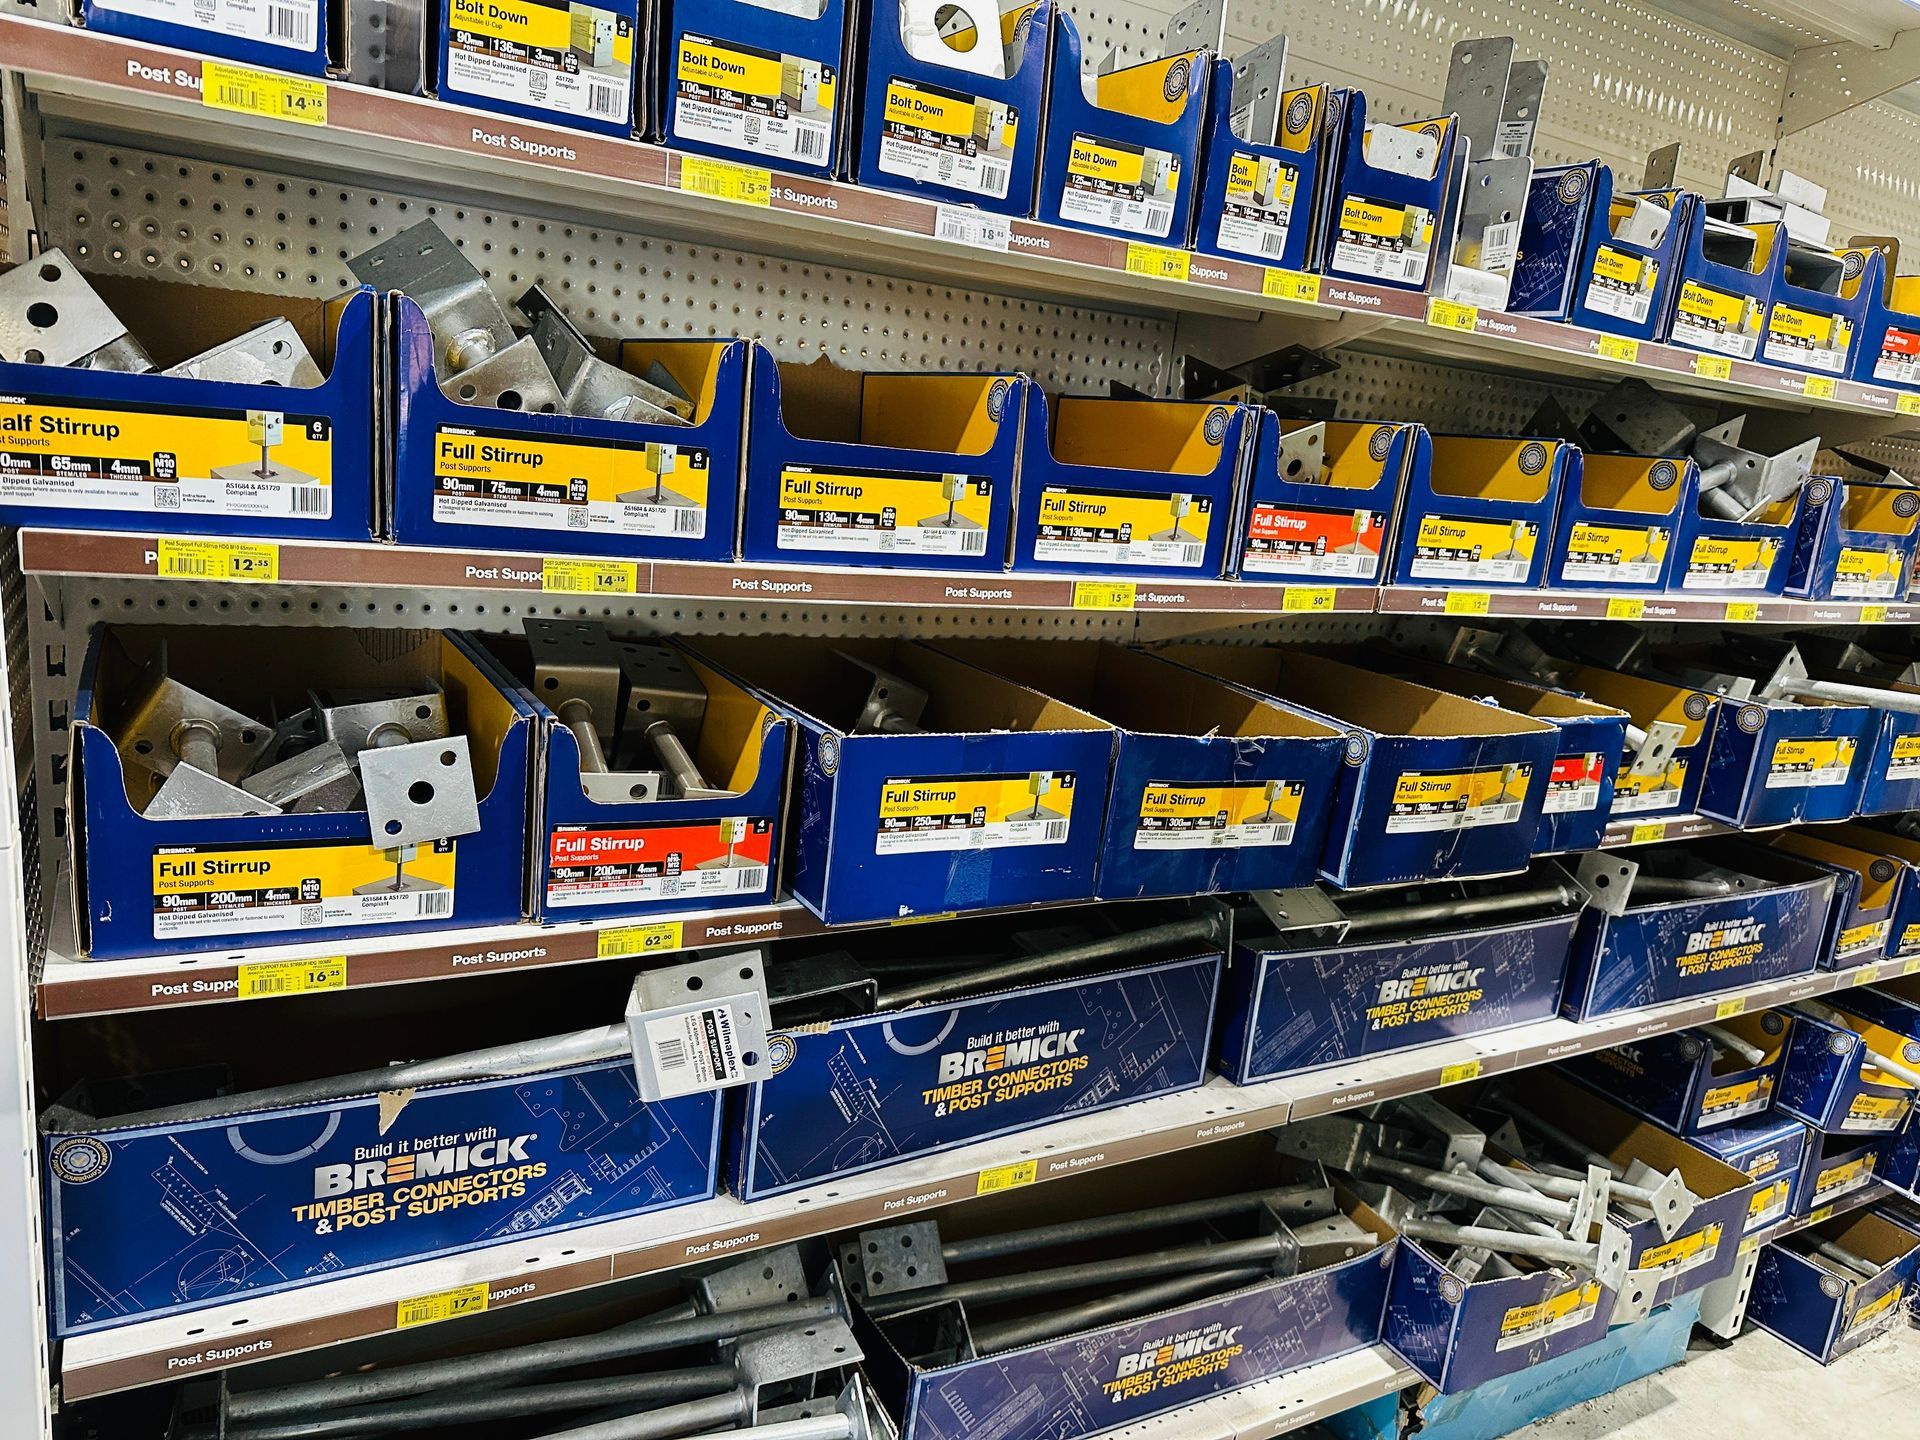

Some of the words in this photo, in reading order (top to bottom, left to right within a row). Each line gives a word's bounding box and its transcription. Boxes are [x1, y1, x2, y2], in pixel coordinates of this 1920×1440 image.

[456, 0, 484, 15] Bolt
[489, 5, 528, 25] Down
[457, 31, 484, 47] 90mm
[494, 39, 525, 56] 136mm
[683, 50, 707, 67] Bolt
[712, 58, 745, 75] Down
[127, 60, 171, 84] Post
[681, 81, 709, 97] 100mm
[890, 94, 911, 109] Bolt
[915, 100, 943, 117] Down
[890, 122, 914, 137] 115mm
[472, 129, 506, 148] Post
[510, 135, 576, 160] Supports
[1073, 149, 1091, 162] Bolt
[1093, 154, 1117, 168] Down
[1232, 164, 1248, 176] Bolt
[1230, 174, 1252, 188] Down
[784, 189, 838, 209] Supports
[1345, 207, 1360, 218] Bolt
[1363, 211, 1382, 223] Down
[1598, 255, 1608, 264] Bolt
[1609, 258, 1623, 269] Down
[1190, 264, 1228, 280] Supports
[1329, 289, 1346, 300] Post
[1348, 291, 1381, 306] Supports
[1683, 290, 1695, 300] Bolt
[1697, 293, 1713, 306] Down
[1773, 311, 1785, 321] Bolt
[1786, 315, 1802, 326] Down
[0, 414, 31, 433] alf
[40, 416, 120, 440] Stirrup
[313, 421, 322, 432] 6
[8, 435, 50, 447] Supports
[155, 458, 175, 468] M10
[441, 442, 475, 460] Full
[481, 446, 543, 468] Stirrup
[695, 452, 702, 461] 6
[51, 456, 91, 473] 65mm
[111, 459, 141, 475] 4mm
[440, 462, 456, 470] Post
[458, 463, 491, 474] Supports
[3, 476, 31, 487] Dipped
[32, 478, 75, 487] Galvanised
[443, 478, 474, 492] 90mm
[490, 481, 521, 495] 75mm
[537, 484, 559, 498] 4mm
[785, 479, 812, 494] Full
[815, 482, 862, 498] Stirrup
[439, 498, 450, 506] Hot
[452, 499, 472, 508] Dipped
[474, 500, 507, 509] Galvanised
[1044, 498, 1065, 511] Full
[1069, 500, 1106, 516] Stirrup
[785, 510, 810, 521] 90mm
[819, 512, 848, 524] 130mm
[856, 514, 874, 525] 4mm
[1254, 514, 1272, 526] Full
[1275, 516, 1306, 530] Stirrup
[1423, 525, 1437, 535] Full
[1439, 526, 1466, 537] Stirrup
[1573, 531, 1584, 541] Full
[1586, 532, 1609, 543] Stirrup
[1695, 544, 1707, 553] Full
[1708, 545, 1728, 554] Stirrup
[466, 566, 499, 580] Post
[732, 579, 759, 590] Post
[762, 580, 812, 593] Supports
[945, 587, 967, 597] Post
[969, 588, 1012, 599] Supports
[1148, 593, 1185, 603] Supports
[1553, 603, 1577, 612] Supports
[1655, 608, 1676, 616] Supports
[1787, 747, 1805, 755] Stirrup
[1399, 781, 1418, 792] Full
[1420, 782, 1451, 792] Stirrup
[886, 791, 909, 803] Full
[913, 789, 956, 802] Stirrup
[1146, 794, 1166, 804] Full
[1170, 793, 1205, 806] Stirrup
[915, 816, 942, 826] 250mm
[1169, 818, 1192, 826] 300mm
[556, 839, 585, 853] Full
[589, 837, 645, 852] Stirrup
[159, 862, 196, 877] Full
[202, 860, 271, 875] Stirrup
[595, 865, 627, 876] 200mm
[159, 880, 176, 888] Post
[178, 878, 214, 888] Supports
[211, 892, 252, 903] 200mm
[706, 927, 731, 937] Post
[734, 921, 782, 935] Supports
[452, 955, 485, 966] Post
[488, 947, 546, 963] Supports
[1676, 952, 1707, 968] TIMBER
[1709, 943, 1763, 963] CONNECTORS
[1686, 963, 1709, 975] POST
[1711, 955, 1753, 971] SUPPORTS
[152, 983, 190, 996] Post
[1366, 1003, 1407, 1020] TIMBER
[1410, 989, 1483, 1010] CONNECTORS
[1381, 1014, 1411, 1028] POST
[1413, 1002, 1470, 1022] SUPPORTS
[706, 1019, 715, 1037] POST
[967, 1036, 992, 1050] Build
[995, 1033, 1002, 1044] it
[1005, 1026, 1037, 1043] better
[1039, 1021, 1060, 1034] with
[721, 1018, 736, 1072] Wilmaplex
[710, 1037, 722, 1072] SUPPORT
[922, 1078, 982, 1105] TIMBER
[987, 1055, 1089, 1091] CONNECTORS
[934, 1103, 947, 1118] &
[948, 1093, 992, 1114] POST
[995, 1072, 1073, 1102] SUPPORTS
[1197, 1127, 1214, 1138] Post
[1214, 1120, 1245, 1134] Supports
[355, 1143, 394, 1161] Build
[398, 1140, 409, 1153] it
[412, 1134, 468, 1152] better
[471, 1127, 497, 1143] with
[1050, 1161, 1069, 1171] Post
[1071, 1153, 1104, 1169] Supports
[292, 1190, 387, 1223] TIMBER
[394, 1162, 548, 1204] CONNECTORS
[883, 1199, 905, 1211] Post
[906, 1188, 947, 1207] Supports
[316, 1218, 332, 1235] &
[336, 1205, 400, 1231] POST
[408, 1180, 526, 1218] SUPPORTS
[686, 1244, 712, 1255] Post
[713, 1231, 760, 1251] Supports
[1640, 1250, 1654, 1263] Full
[1654, 1247, 1671, 1259] Stirrup
[168, 1355, 202, 1370] Post
[206, 1339, 272, 1362] Supports
[1103, 1372, 1152, 1395] TIMBER
[1157, 1344, 1243, 1379] CONNECTORS
[1123, 1382, 1157, 1400] POST
[1163, 1359, 1229, 1387] SUPPORTS
